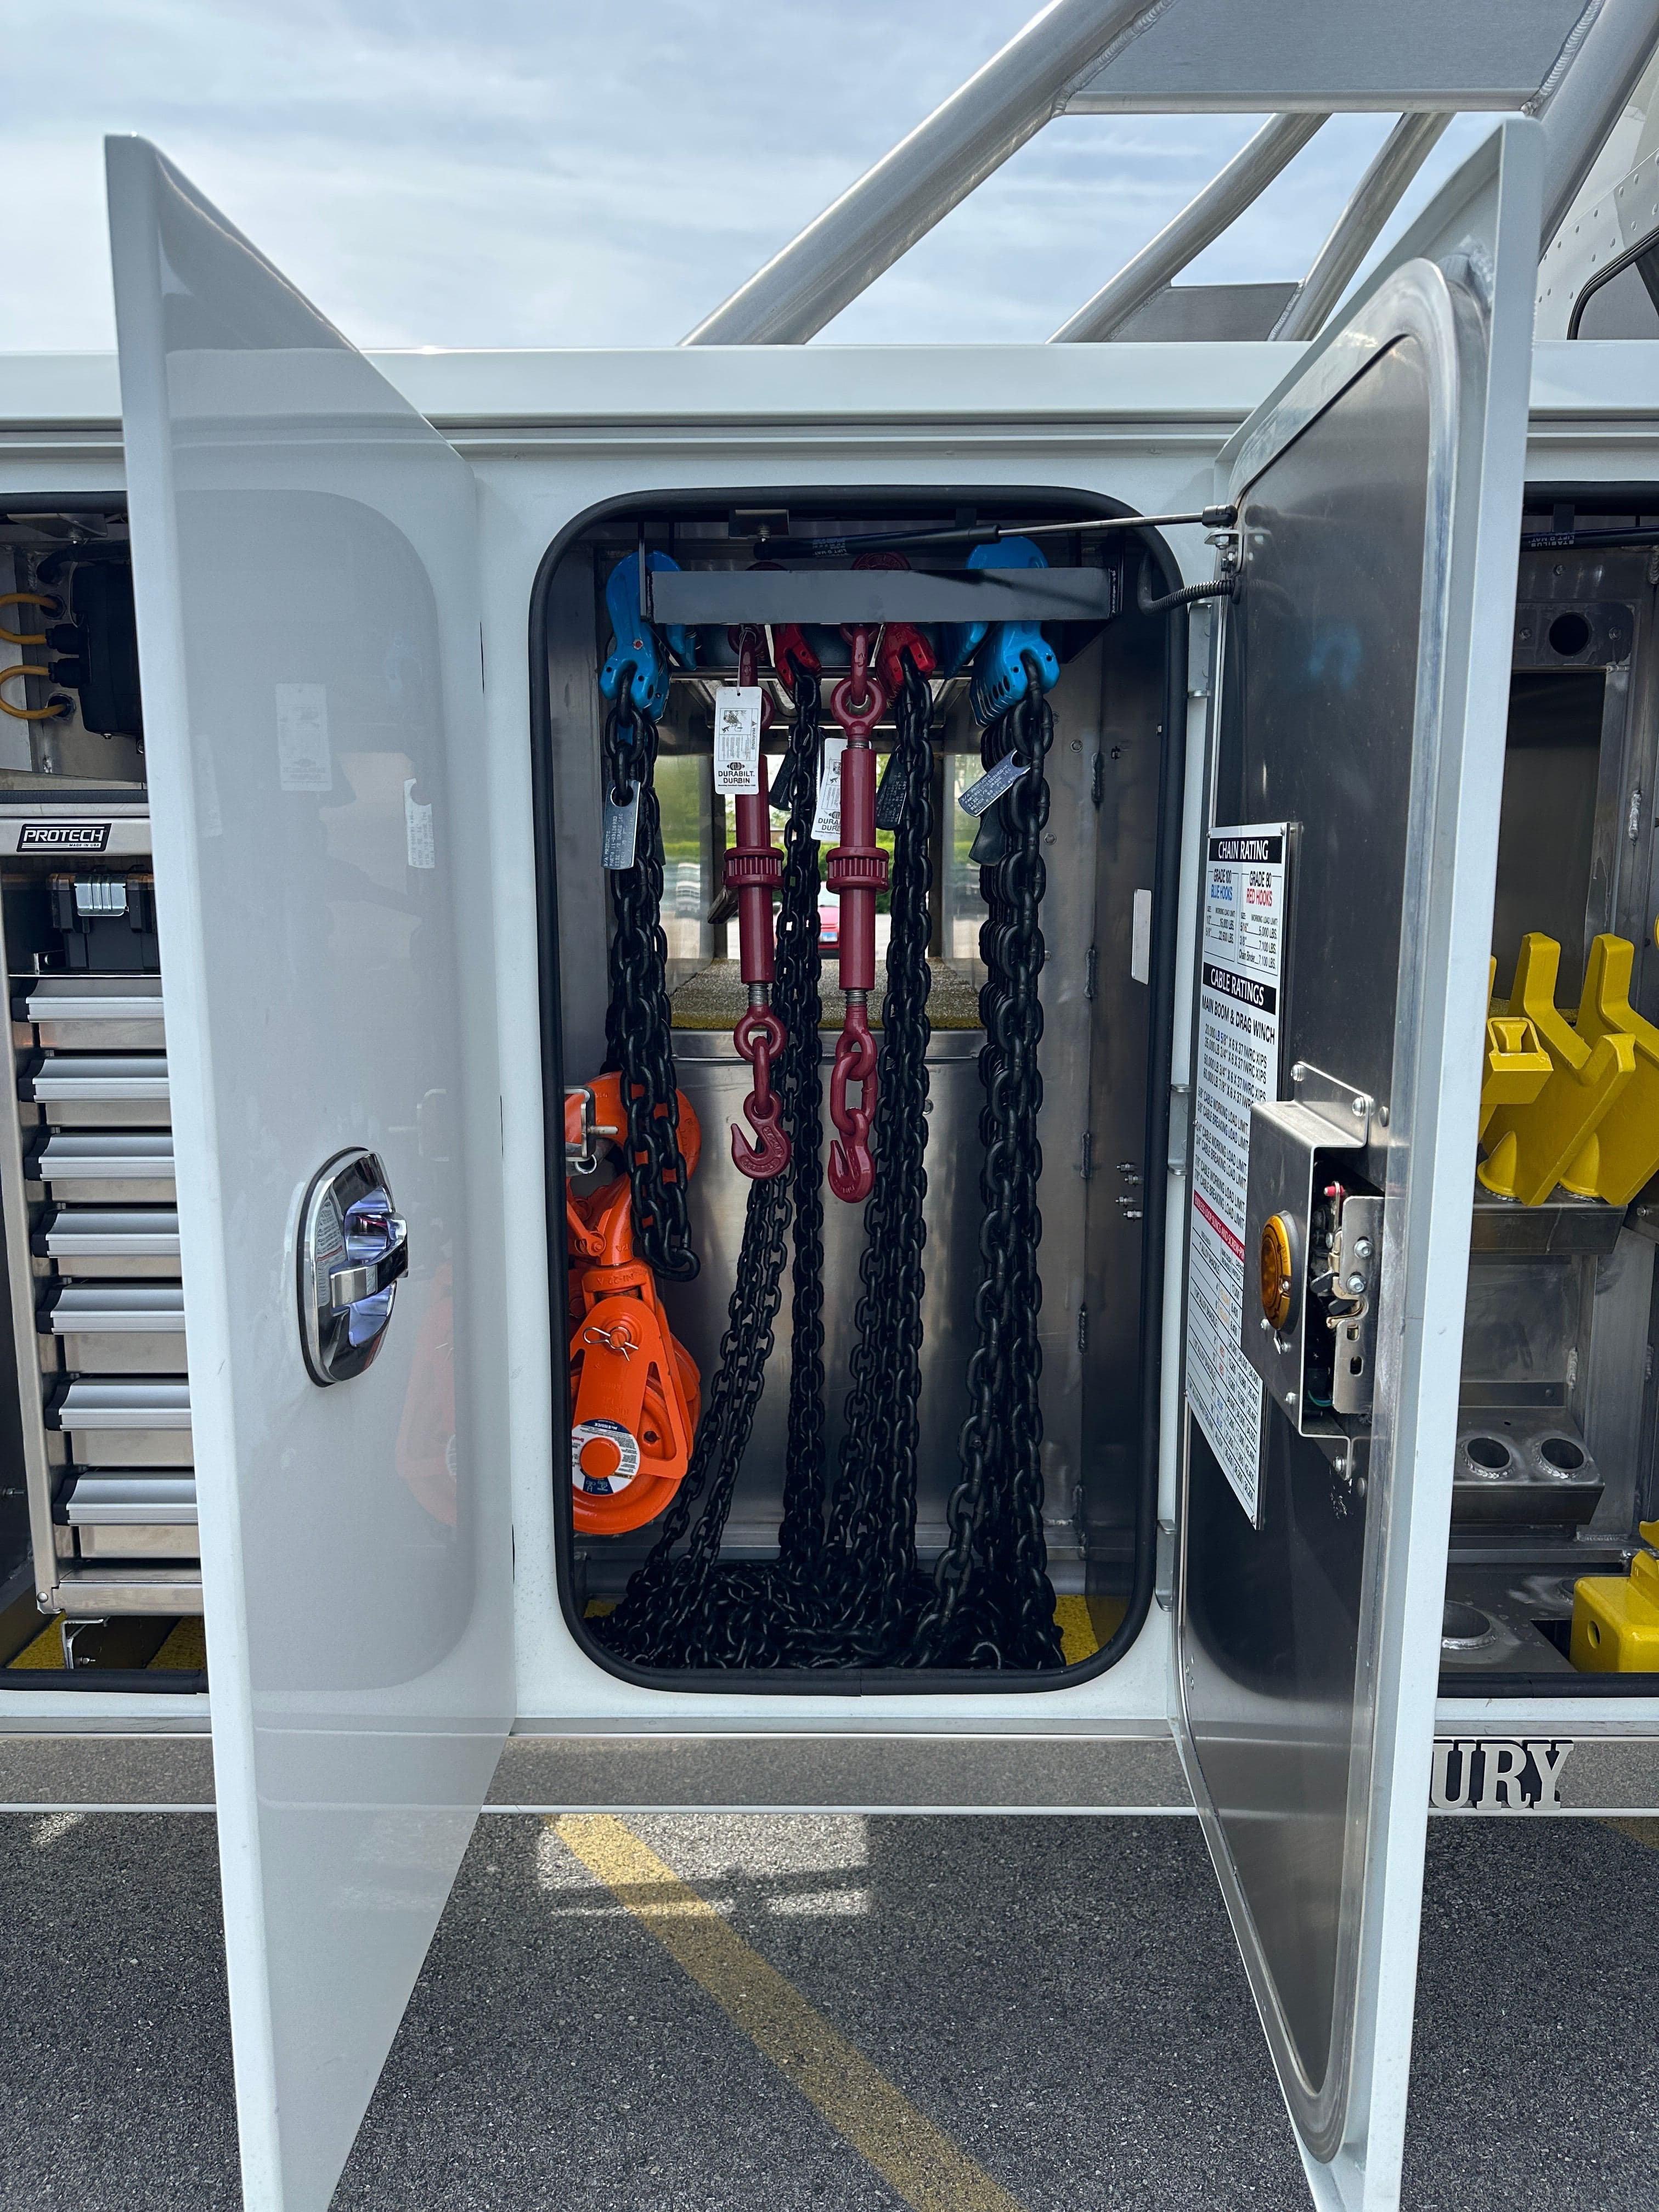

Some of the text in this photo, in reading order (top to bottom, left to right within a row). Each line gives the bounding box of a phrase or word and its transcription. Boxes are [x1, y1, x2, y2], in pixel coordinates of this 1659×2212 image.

[24, 830, 103, 842] PROTECH
[1218, 839, 1268, 860] CHAIN RATING
[1211, 884, 1232, 901] BLUE HOOKS
[1214, 868, 1225, 883] GRADE
[1249, 871, 1271, 888] GRADE 80
[1246, 888, 1272, 907] RED HOOKS
[1259, 926, 1268, 939] 5,000
[1259, 940, 1268, 953] 7,100
[1268, 943, 1277, 955] LBS.
[1246, 951, 1255, 963] Binder
[1259, 955, 1268, 967] 7,100
[1211, 968, 1263, 1005] CABLE RATINGS
[1202, 995, 1274, 1043] MAIN BOOM & DRAG WINCH
[1215, 1030, 1220, 1041] LB
[1228, 1037, 1232, 1048] X
[1232, 1039, 1234, 1051] 6
[1234, 1040, 1238, 1052] X
[1238, 1042, 1243, 1054] 37
[1244, 1045, 1255, 1062] IWRC
[1256, 1052, 1266, 1069] XIPS
[1215, 1043, 1219, 1055] LB
[1228, 1051, 1231, 1063] X
[1231, 1053, 1234, 1065] 6
[1234, 1054, 1237, 1066] X
[1238, 1057, 1243, 1069] 37
[1243, 1060, 1255, 1077] IWRC
[1255, 1067, 1266, 1084] XIPS
[1214, 1060, 1218, 1073] LB
[1227, 1069, 1230, 1081] X
[1231, 1071, 1233, 1083] 6
[1233, 1073, 1237, 1085] X
[1237, 1075, 1242, 1088] 37
[1242, 1079, 1254, 1097] IWRC
[1255, 1087, 1266, 1101] XIPS
[1214, 1075, 1218, 1087] LB
[1226, 1084, 1229, 1096] X
[1230, 1087, 1232, 1098] 6
[1233, 1089, 1236, 1101] X
[1237, 1091, 1242, 1104] 37
[1203, 1105, 1212, 1122] CABLE
[1212, 1113, 1227, 1136] BREAKING
[1228, 1127, 1237, 1143] LOAD
[1204, 1091, 1212, 1107] CABLE
[1213, 1098, 1227, 1119] WORKING
[1228, 1111, 1237, 1127] LOAD
[1201, 1139, 1210, 1156] CABLE
[1210, 1148, 1226, 1172] BREAKING
[1226, 1164, 1235, 1181] LOAD
[1202, 1126, 1211, 1143] CABLE
[1211, 1135, 1226, 1157] WORKING
[1226, 1149, 1235, 1165] LOAD
[1200, 1160, 1209, 1178] CABLE
[1210, 1170, 1224, 1193] WORKING
[1224, 1186, 1234, 1203] LOAD
[1200, 1175, 1209, 1193] CABLE
[1209, 1184, 1224, 1209] BREAKING
[1224, 1201, 1233, 1219] LOAD
[1209, 1254, 1219, 1274] SHACKLE
[1206, 1305, 1217, 1328] SHACKLE
[1228, 1338, 1237, 1356] 24,000
[1238, 1352, 1247, 1371] 24,000
[1249, 1367, 1258, 1386] 24,000
[1205, 1357, 1215, 1381] SHACKLE
[1236, 1408, 1245, 1427] 34,000
[1246, 1424, 1255, 1444] 34,000
[1235, 1446, 1243, 1466] 17,000
[1236, 1427, 1244, 1447] 17,000
[1245, 1444, 1255, 1464] 42,400
[1431, 1743, 1574, 1810] URY
